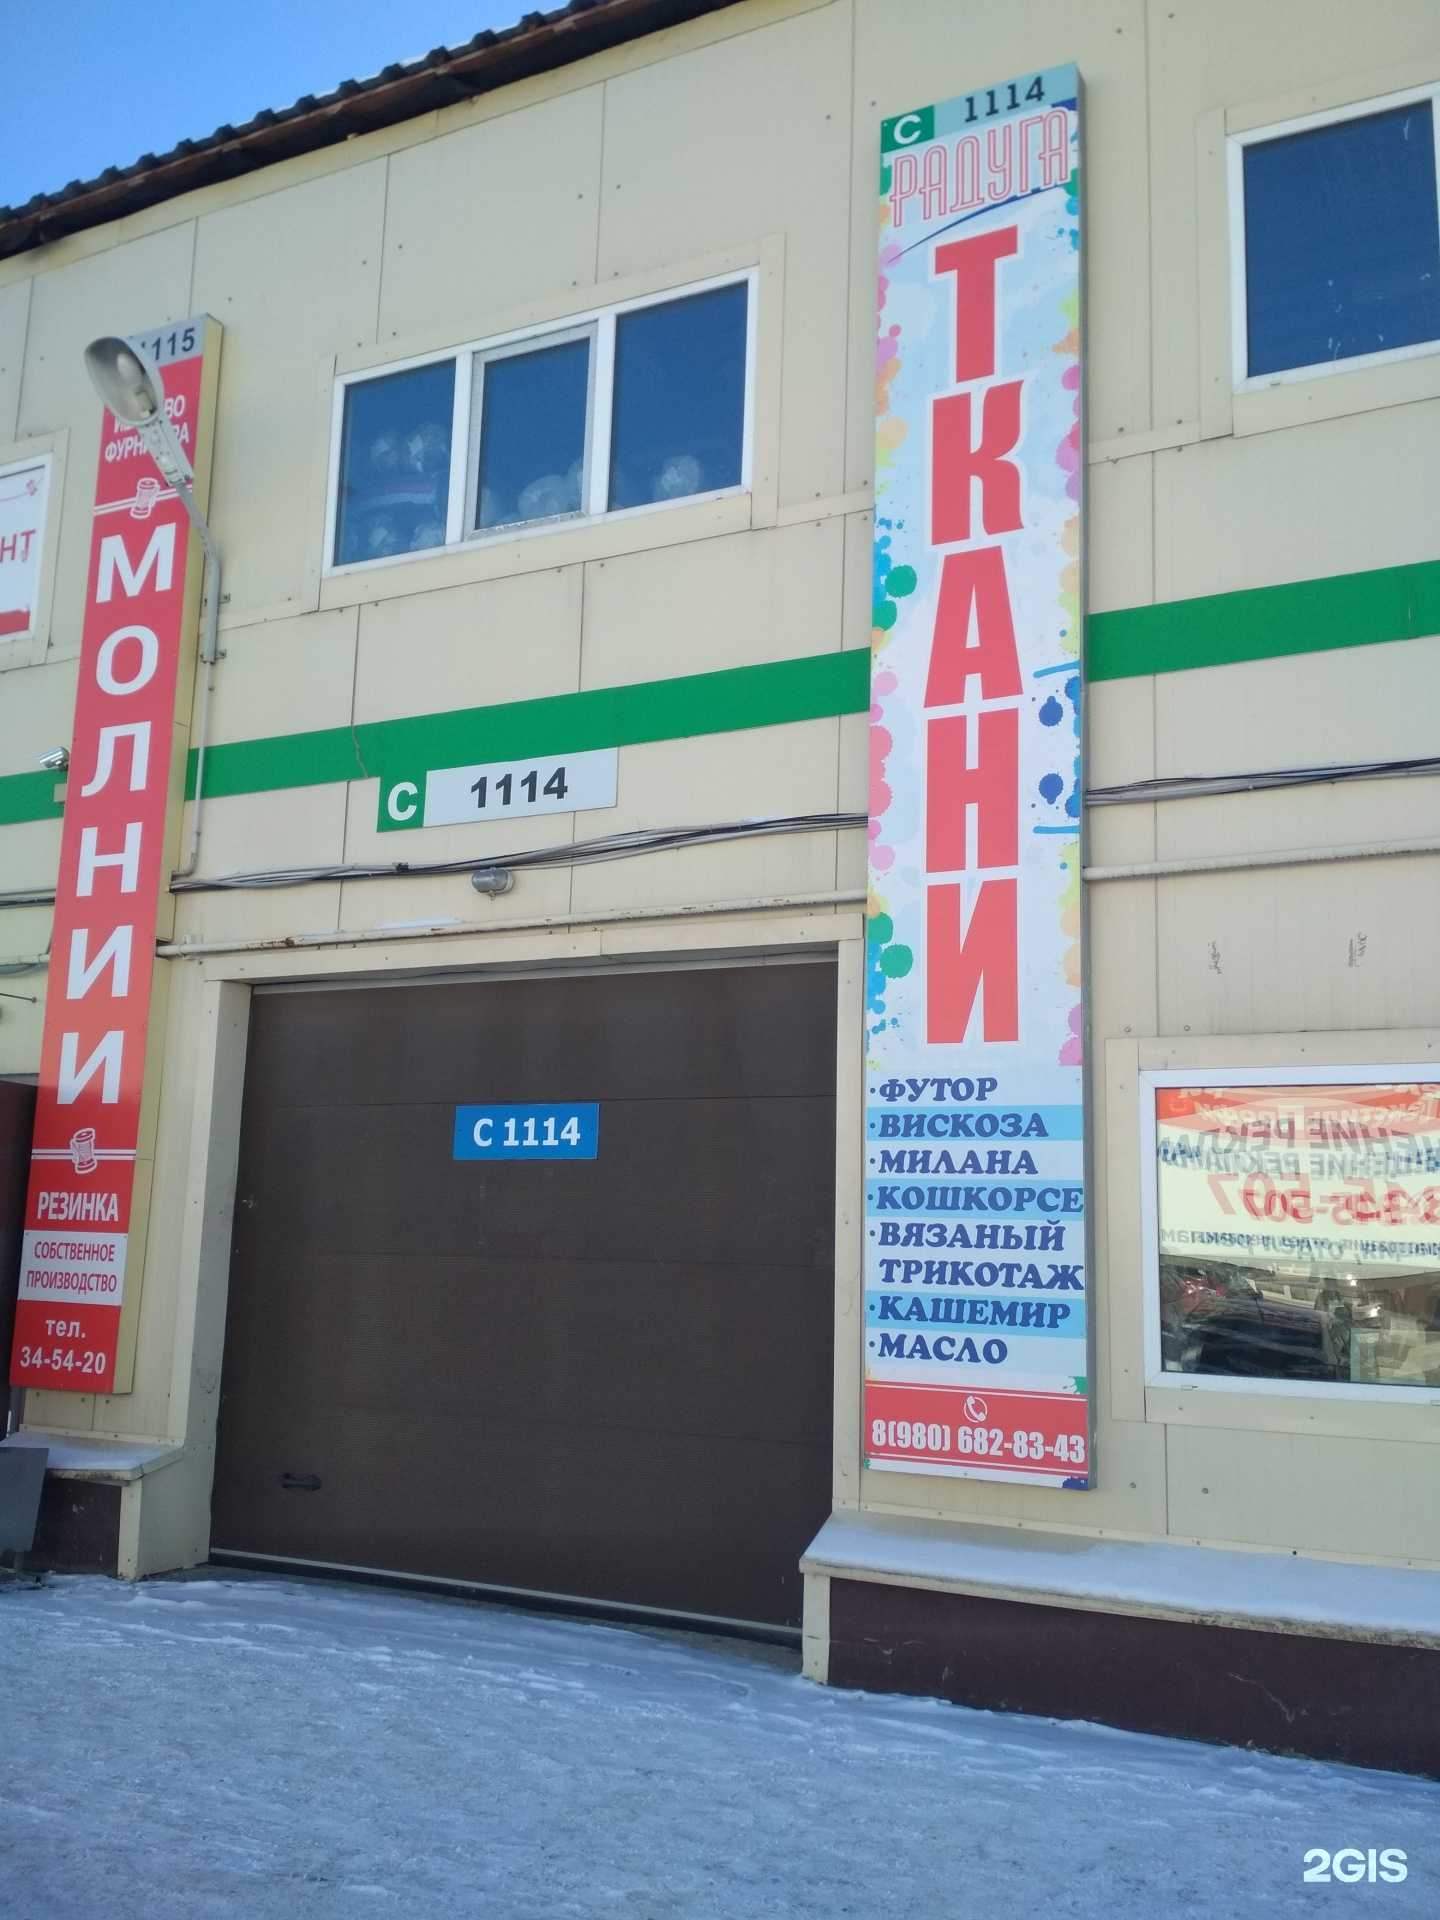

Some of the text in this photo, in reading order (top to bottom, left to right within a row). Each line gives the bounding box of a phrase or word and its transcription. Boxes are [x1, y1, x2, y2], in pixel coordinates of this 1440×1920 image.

[964, 76, 1046, 123] 1114
[888, 105, 1071, 228] РАДУГА
[140, 327, 195, 361] 115
[922, 225, 1025, 1044] ТКАНИ
[470, 767, 568, 809] 1114
[56, 523, 178, 1106] МОЛНИИ
[879, 1077, 998, 1103] ФУТОР
[503, 1116, 581, 1147] 1114
[878, 1112, 1049, 1138] ВИСКОЗА
[878, 1149, 1039, 1175] МИЛАНА
[37, 1191, 119, 1222] РЕЗИНКА
[876, 1185, 1084, 1213] КОШКОРСЕ
[878, 1219, 1066, 1251] ВЯЗАНЫЙ
[34, 1241, 115, 1262] СОБСТВЕННОЕ
[26, 1270, 117, 1295] ПРОИЗВОДСТВО
[879, 1258, 1085, 1291] ТРИКОТАЖ
[45, 1318, 87, 1338] тел.
[878, 1295, 1071, 1329] КАШЕМИР
[20, 1346, 107, 1375] 34-54-20
[878, 1333, 1008, 1365] МАСЛО
[872, 1418, 951, 1452] 8(980)
